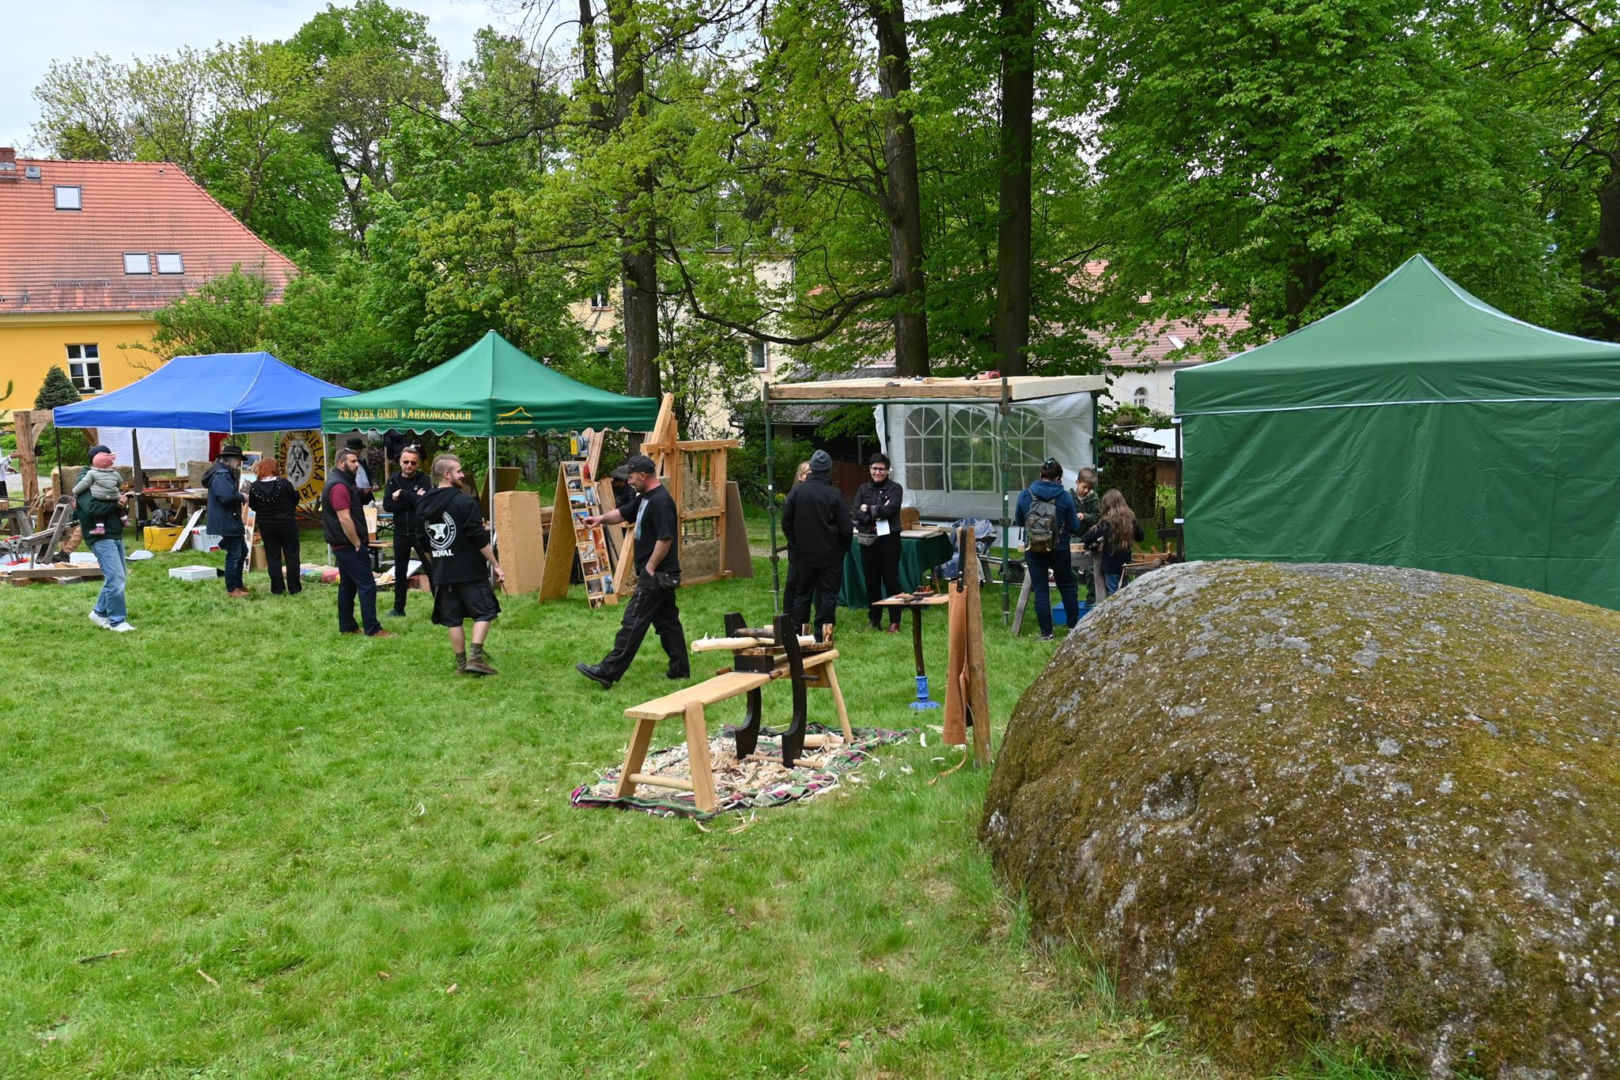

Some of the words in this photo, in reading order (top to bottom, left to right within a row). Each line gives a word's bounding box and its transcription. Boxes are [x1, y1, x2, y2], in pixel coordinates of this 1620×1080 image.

[338, 408, 374, 421] ZWIĄZEK
[377, 408, 398, 419] GMIN
[401, 408, 472, 420] KARKONOSKICH
